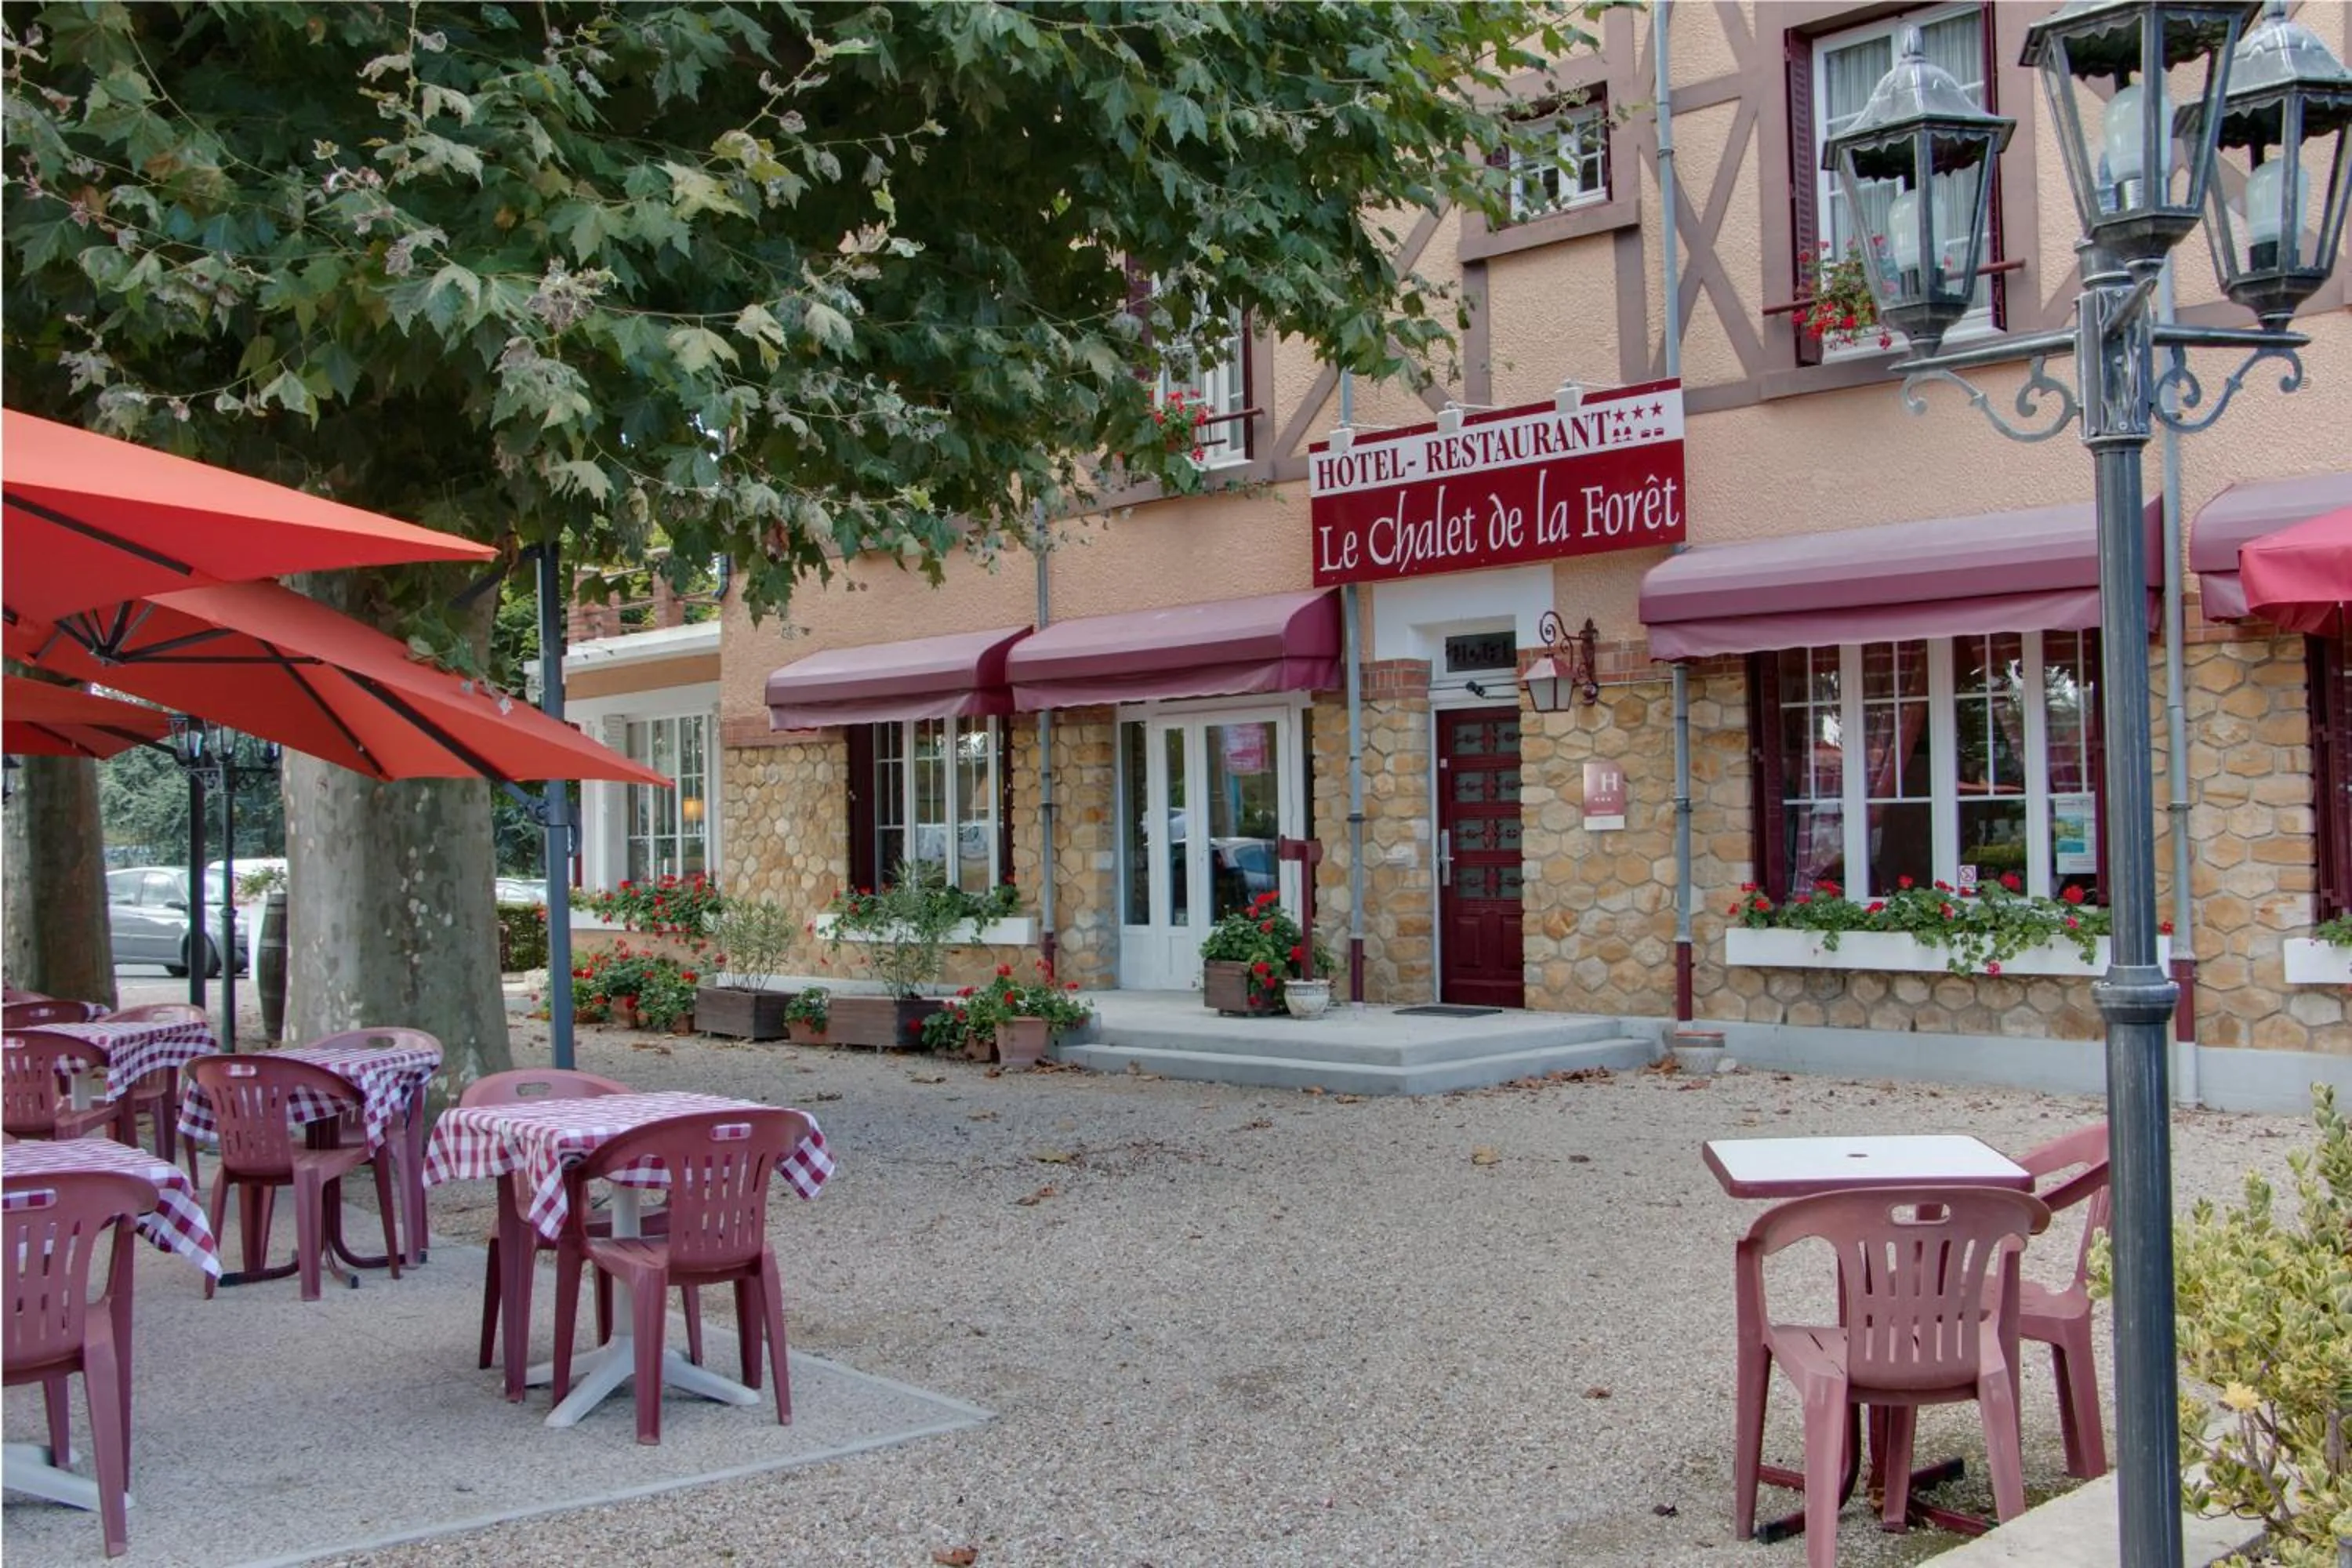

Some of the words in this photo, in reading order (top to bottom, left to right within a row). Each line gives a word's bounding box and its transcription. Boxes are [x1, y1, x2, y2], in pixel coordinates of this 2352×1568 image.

[1425, 410, 1610, 474] RESTAURANT
[1319, 525, 1359, 572] Le
[1368, 485, 1478, 573] Chalet
[1488, 492, 1524, 551] de
[1537, 469, 1570, 545] la
[1581, 474, 1679, 537] Forêt
[1602, 772, 1618, 791] H
